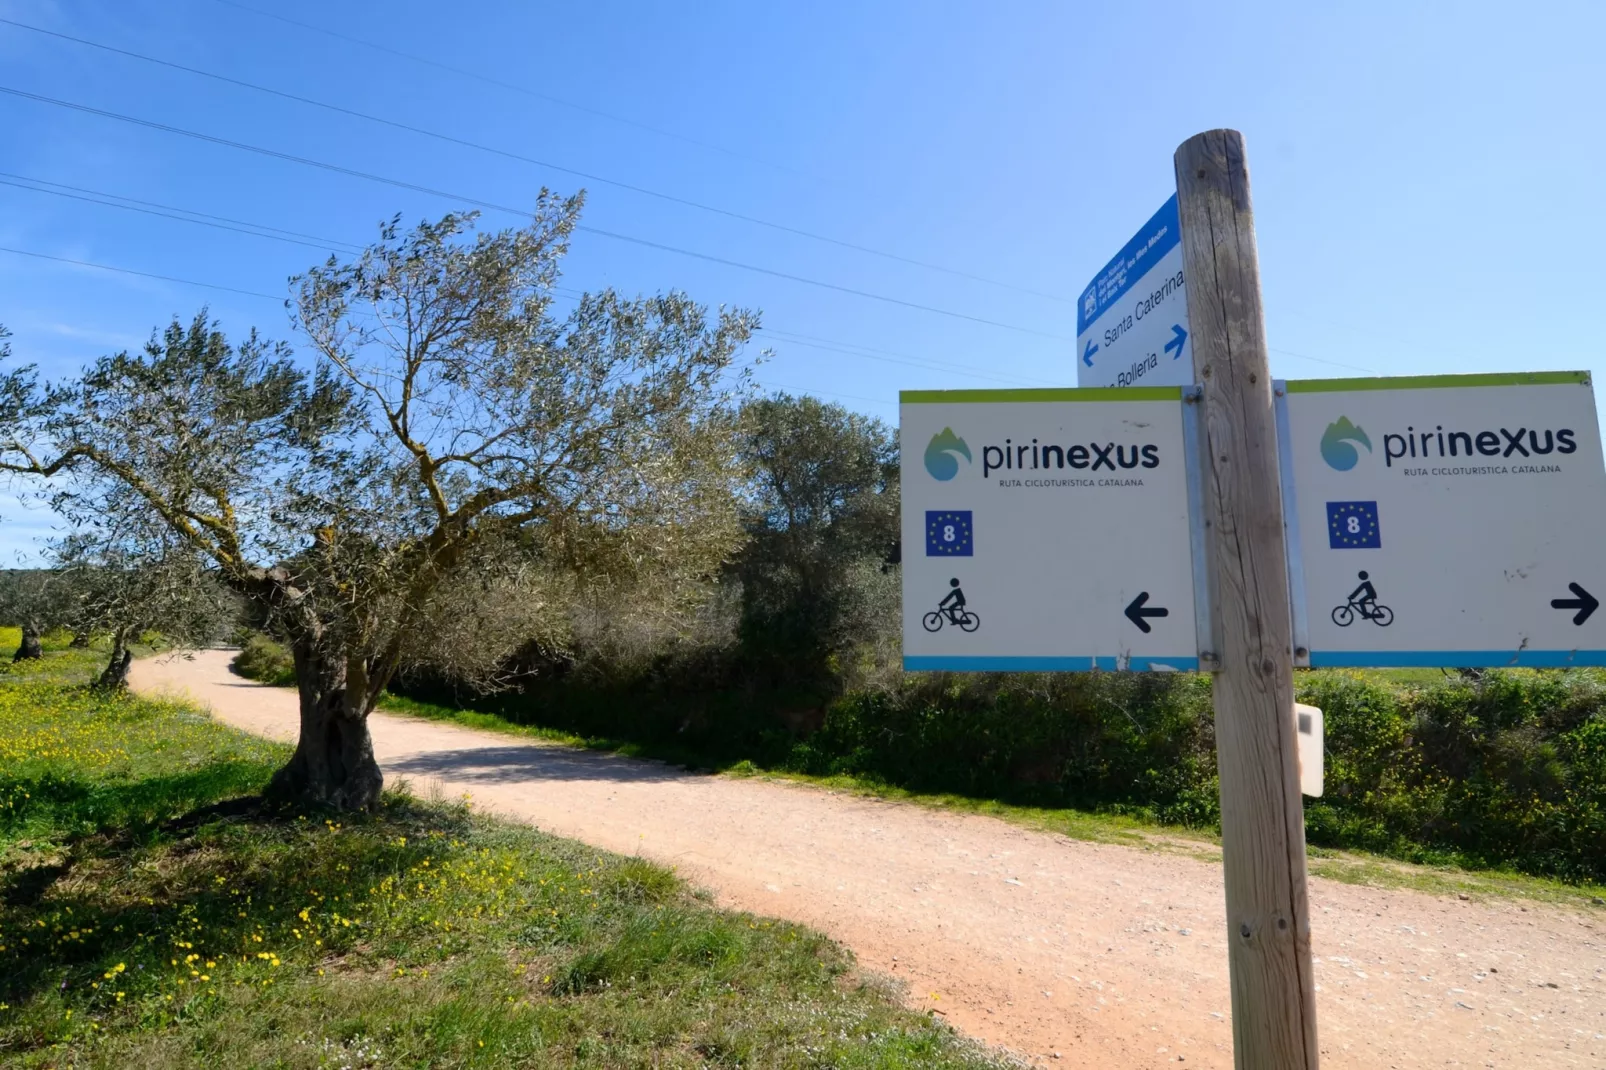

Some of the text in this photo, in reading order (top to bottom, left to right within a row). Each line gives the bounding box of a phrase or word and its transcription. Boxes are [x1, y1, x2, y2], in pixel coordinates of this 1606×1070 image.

[1104, 315, 1133, 347] Santa
[1135, 270, 1185, 321] Caterina
[1117, 352, 1158, 388] Bolleria
[982, 438, 1160, 479] pirinexus
[1383, 424, 1578, 468] pirinexus
[999, 479, 1022, 488] RUTA
[1097, 478, 1144, 487] CATALANA
[1403, 467, 1429, 477] RUTA
[1511, 464, 1562, 474] CATALANA
[943, 525, 956, 542] 8
[1346, 516, 1361, 534] 8
